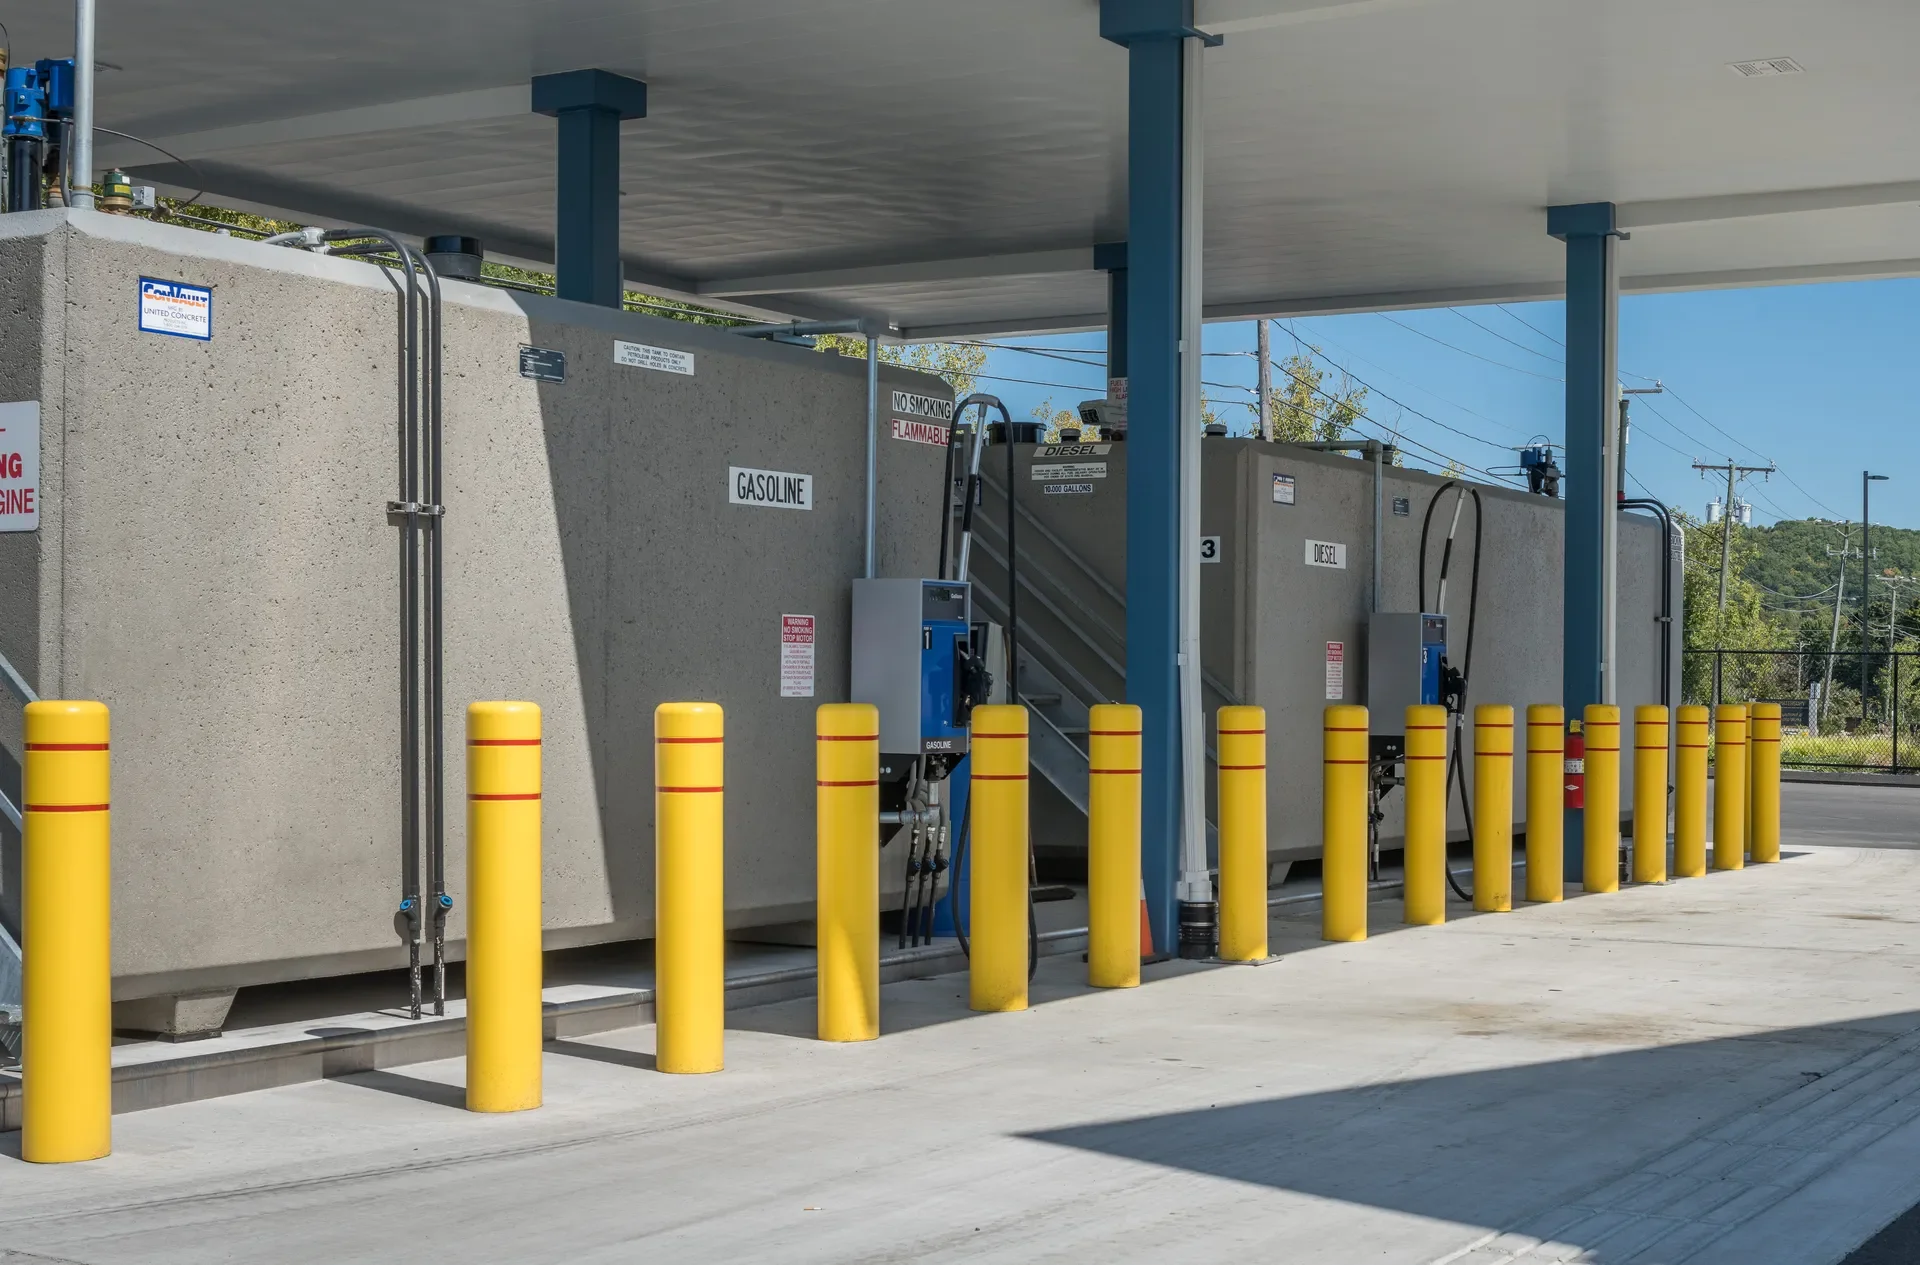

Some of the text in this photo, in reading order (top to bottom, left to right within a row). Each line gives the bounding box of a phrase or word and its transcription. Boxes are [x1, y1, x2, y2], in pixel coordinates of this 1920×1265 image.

[144, 308, 206, 323] UNITED CONCRETE
[628, 352, 649, 360] PETROLEUM
[651, 355, 670, 363] PRODUCTS
[668, 364, 687, 372] CONCRETE
[894, 392, 951, 419] NO SMOKING
[1044, 445, 1097, 456] DIESEL
[738, 472, 804, 504] GASOLINE
[1064, 484, 1092, 492] GALLONS
[0, 488, 34, 515] GINE
[1201, 539, 1215, 558] 3
[1315, 544, 1337, 564] DIESEL
[925, 632, 929, 650] 1
[1423, 650, 1428, 664] 3
[926, 741, 952, 749] GASOLINE
